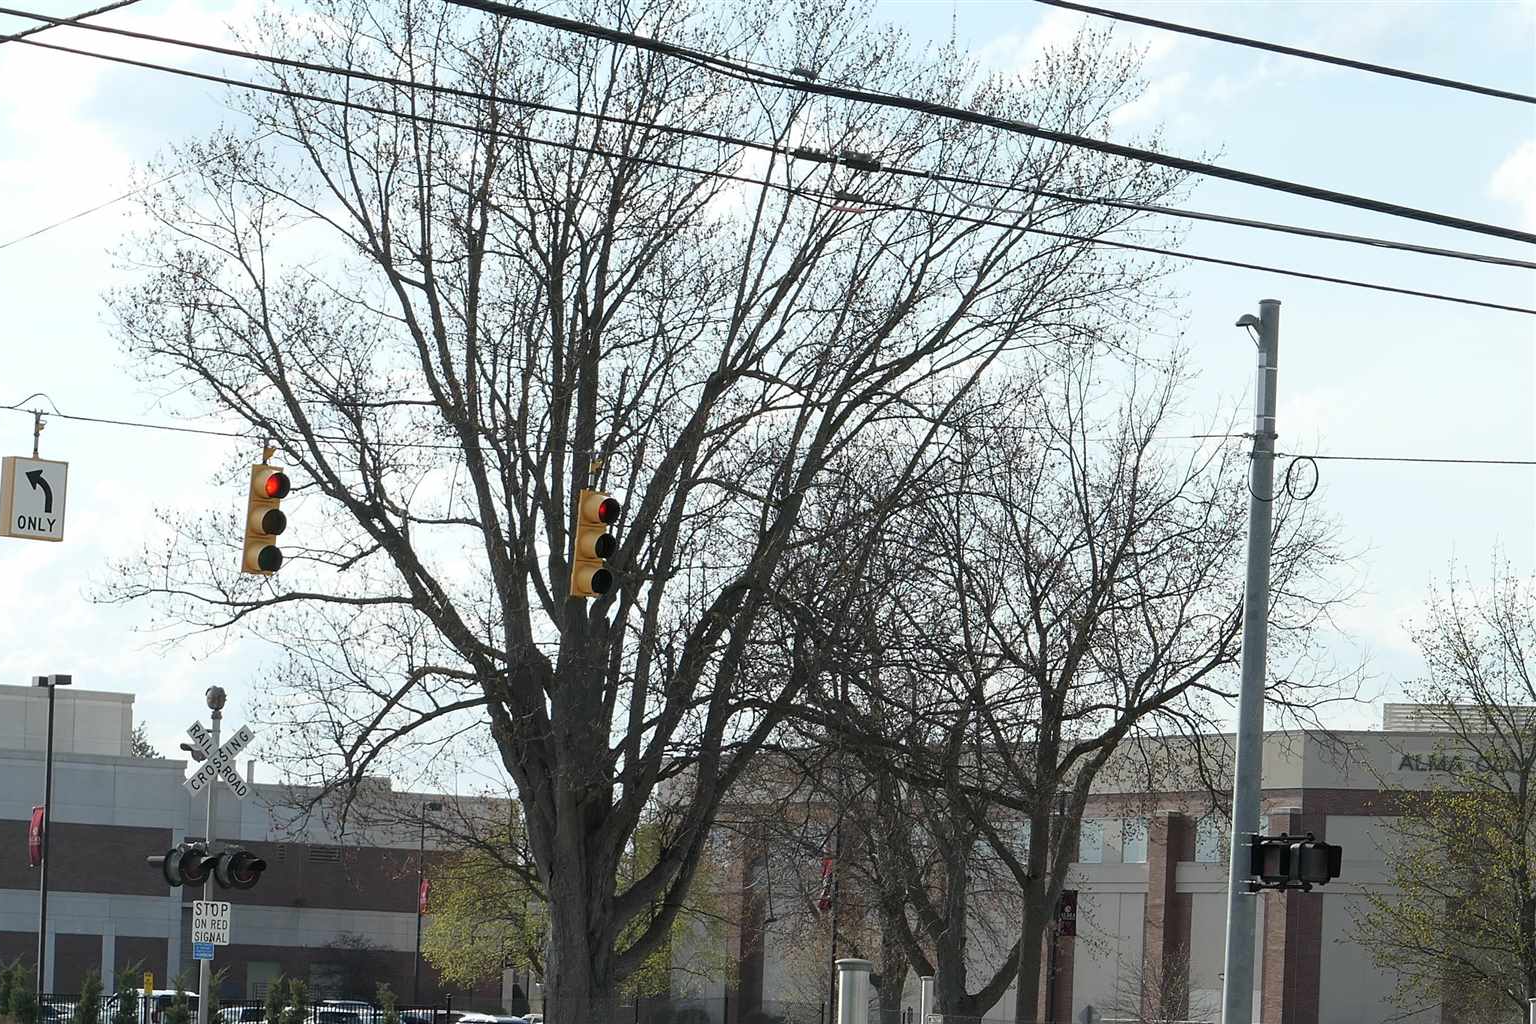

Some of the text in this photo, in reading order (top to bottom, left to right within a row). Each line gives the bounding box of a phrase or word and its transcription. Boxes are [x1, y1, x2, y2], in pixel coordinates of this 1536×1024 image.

[17, 515, 56, 532] ONLY
[190, 724, 247, 796] RAIL ROAD
[191, 731, 249, 790] CROSSING
[195, 902, 228, 917] STOP
[195, 919, 228, 930] ON RED
[194, 931, 228, 944] SIGNAL
